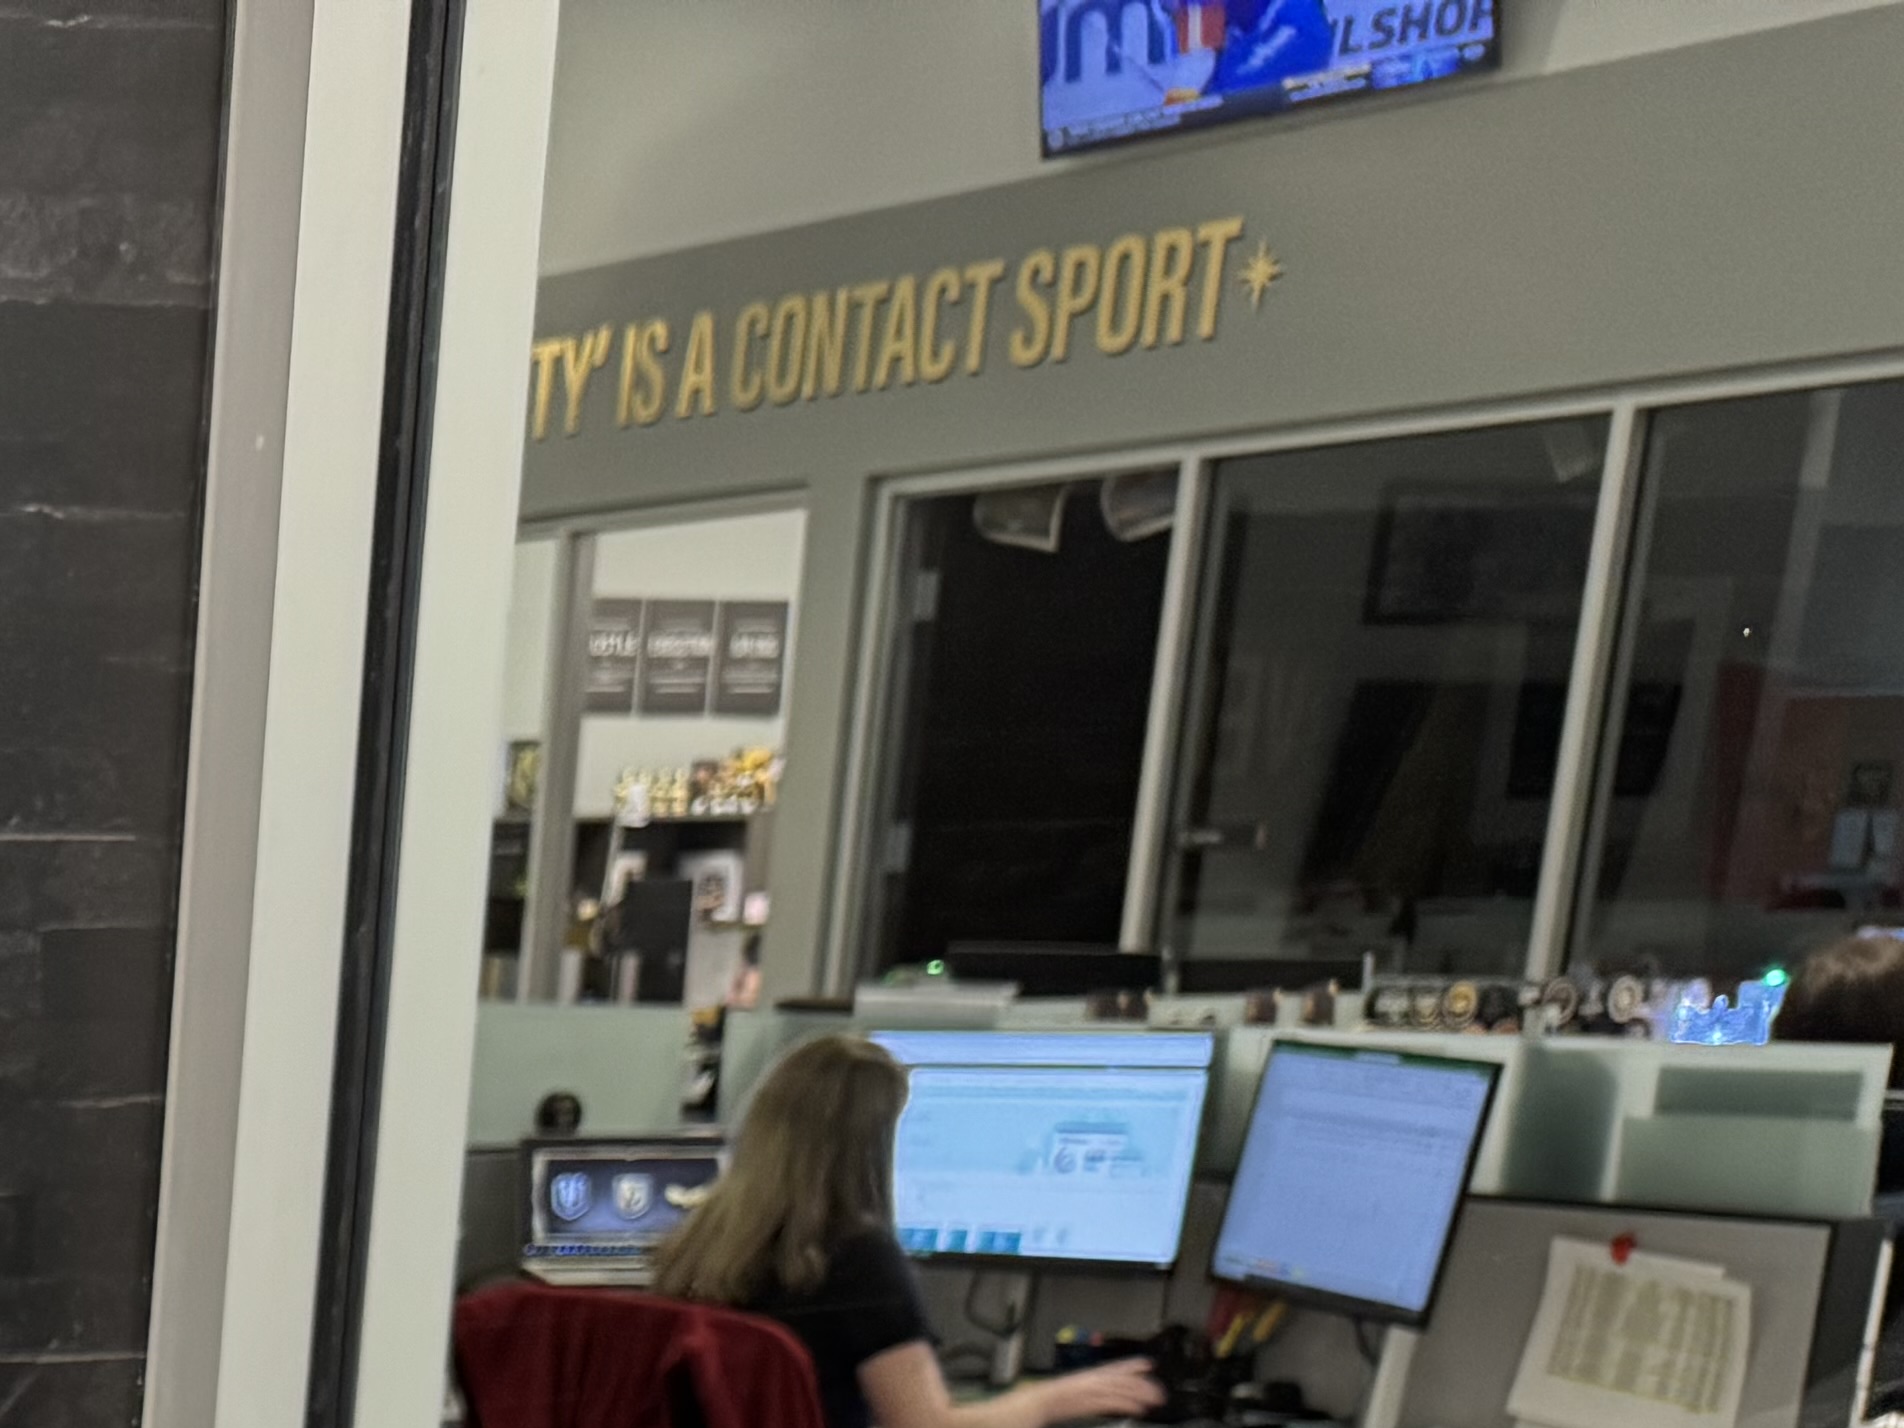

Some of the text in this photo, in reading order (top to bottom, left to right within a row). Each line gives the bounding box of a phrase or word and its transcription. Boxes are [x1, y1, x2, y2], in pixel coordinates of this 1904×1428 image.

[616, 318, 670, 431] IS
[675, 311, 716, 420] A
[730, 258, 1005, 413] CONTACT
[1008, 215, 1244, 368] SPORT
